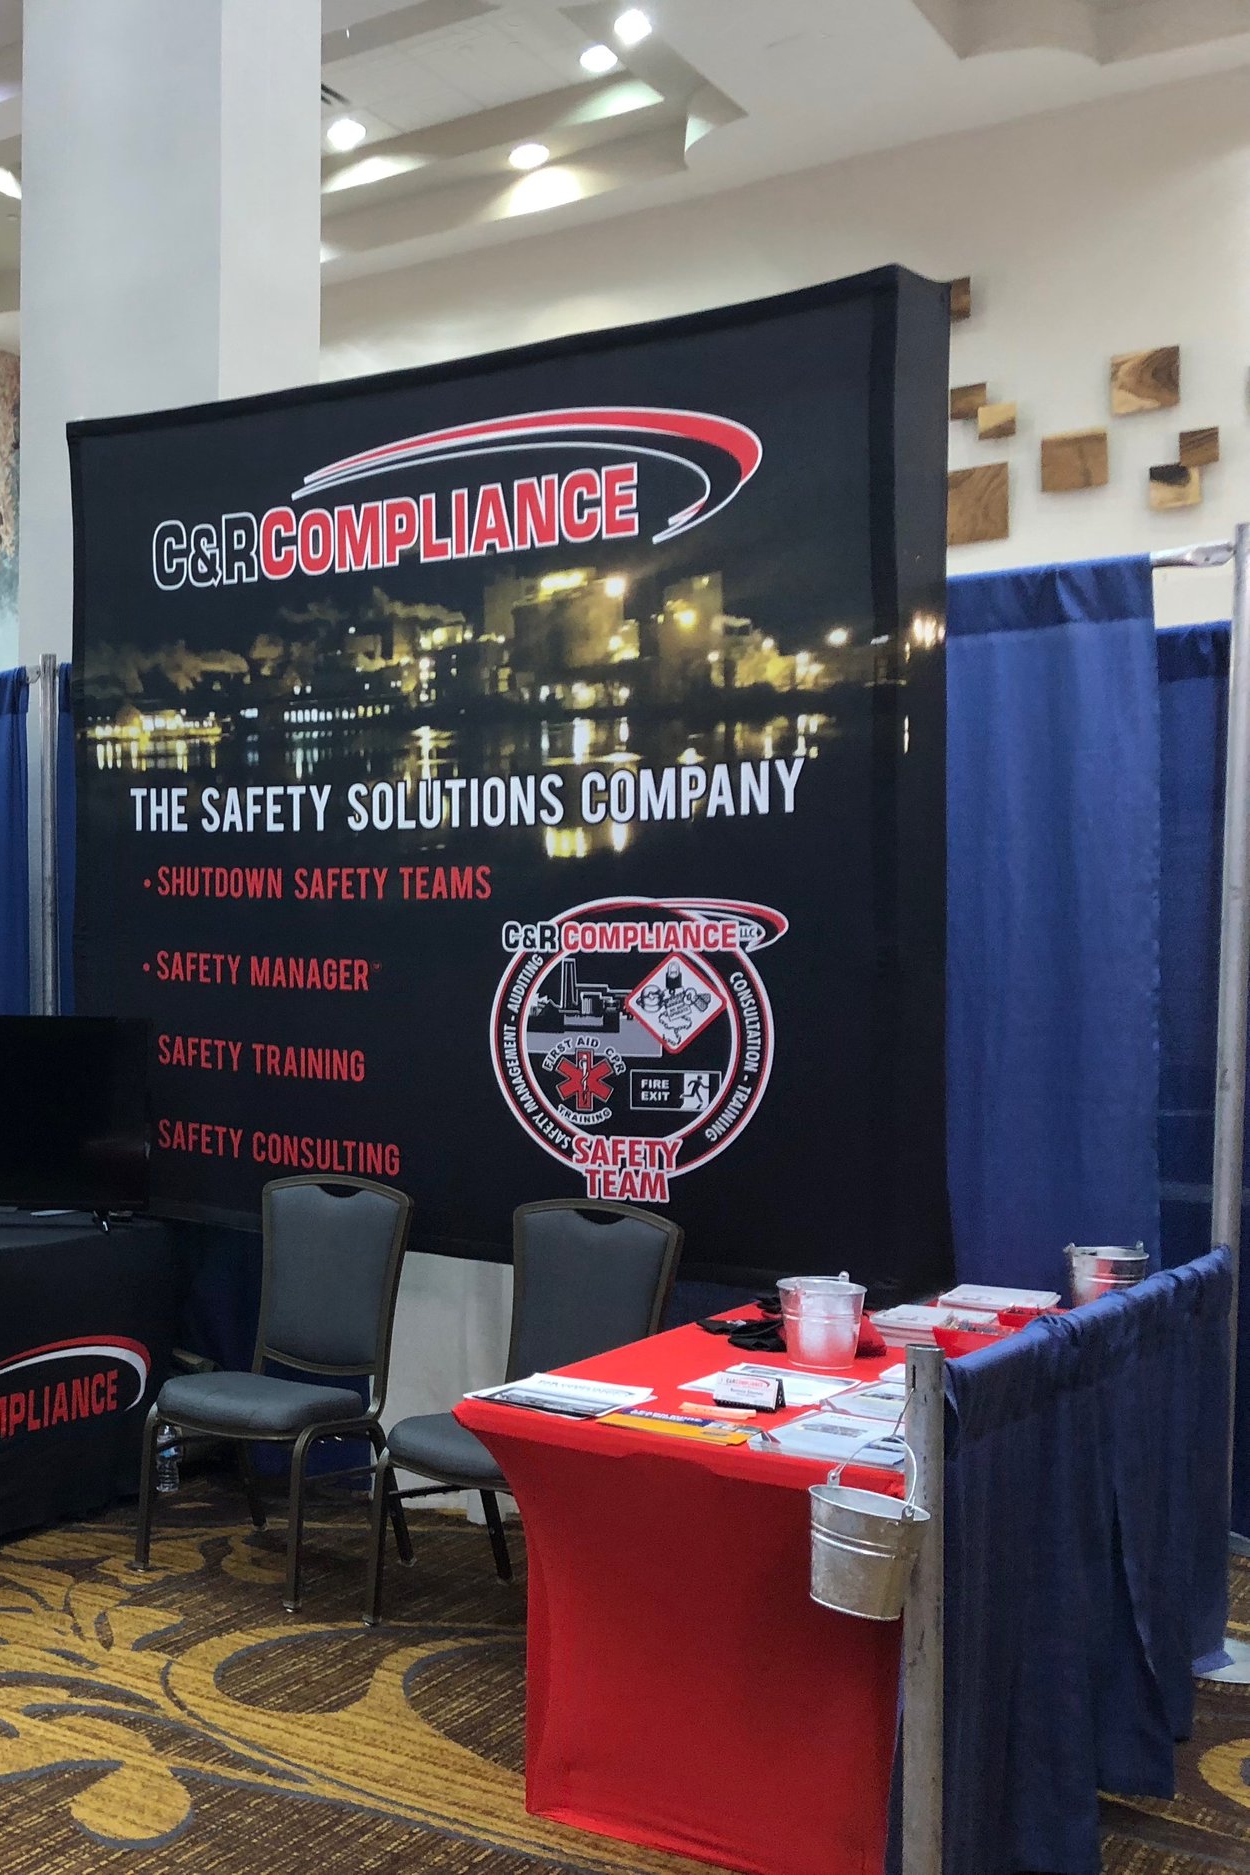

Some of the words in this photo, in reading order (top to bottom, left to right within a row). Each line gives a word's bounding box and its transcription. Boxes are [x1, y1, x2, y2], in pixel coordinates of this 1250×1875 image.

[130, 786, 188, 832] THE
[201, 784, 331, 833] SAFETY
[347, 772, 564, 832] SOLUTIONS
[580, 758, 806, 824] COMPANY
[156, 866, 283, 899] SHUTDOWN
[294, 867, 389, 900] SAFETY
[399, 865, 493, 899] TEAMS
[502, 920, 560, 952] C&R
[561, 922, 739, 952] COMPLIANCE
[156, 950, 241, 985] SAFETY
[250, 956, 369, 991] MANAGER
[507, 953, 544, 1014] AUDITING
[730, 971, 761, 1073] CONSULTATION
[157, 1034, 242, 1072] SAFETY
[252, 1043, 366, 1082] TRAINING
[504, 1024, 539, 1114] MANAGEMENT
[542, 1037, 573, 1072] FIRST
[577, 1036, 600, 1049] AID
[605, 1046, 627, 1076] CPR
[641, 1079, 670, 1090] FIRE
[641, 1091, 671, 1102] EXIT
[532, 1113, 572, 1149] SAFETY
[557, 1104, 612, 1125] TRAINING
[705, 1084, 752, 1142] TRAINING
[157, 1118, 243, 1158] SAFETY
[252, 1131, 400, 1176] CONSULTING
[572, 1136, 683, 1170] SAFETY
[584, 1168, 670, 1203] TEAM
